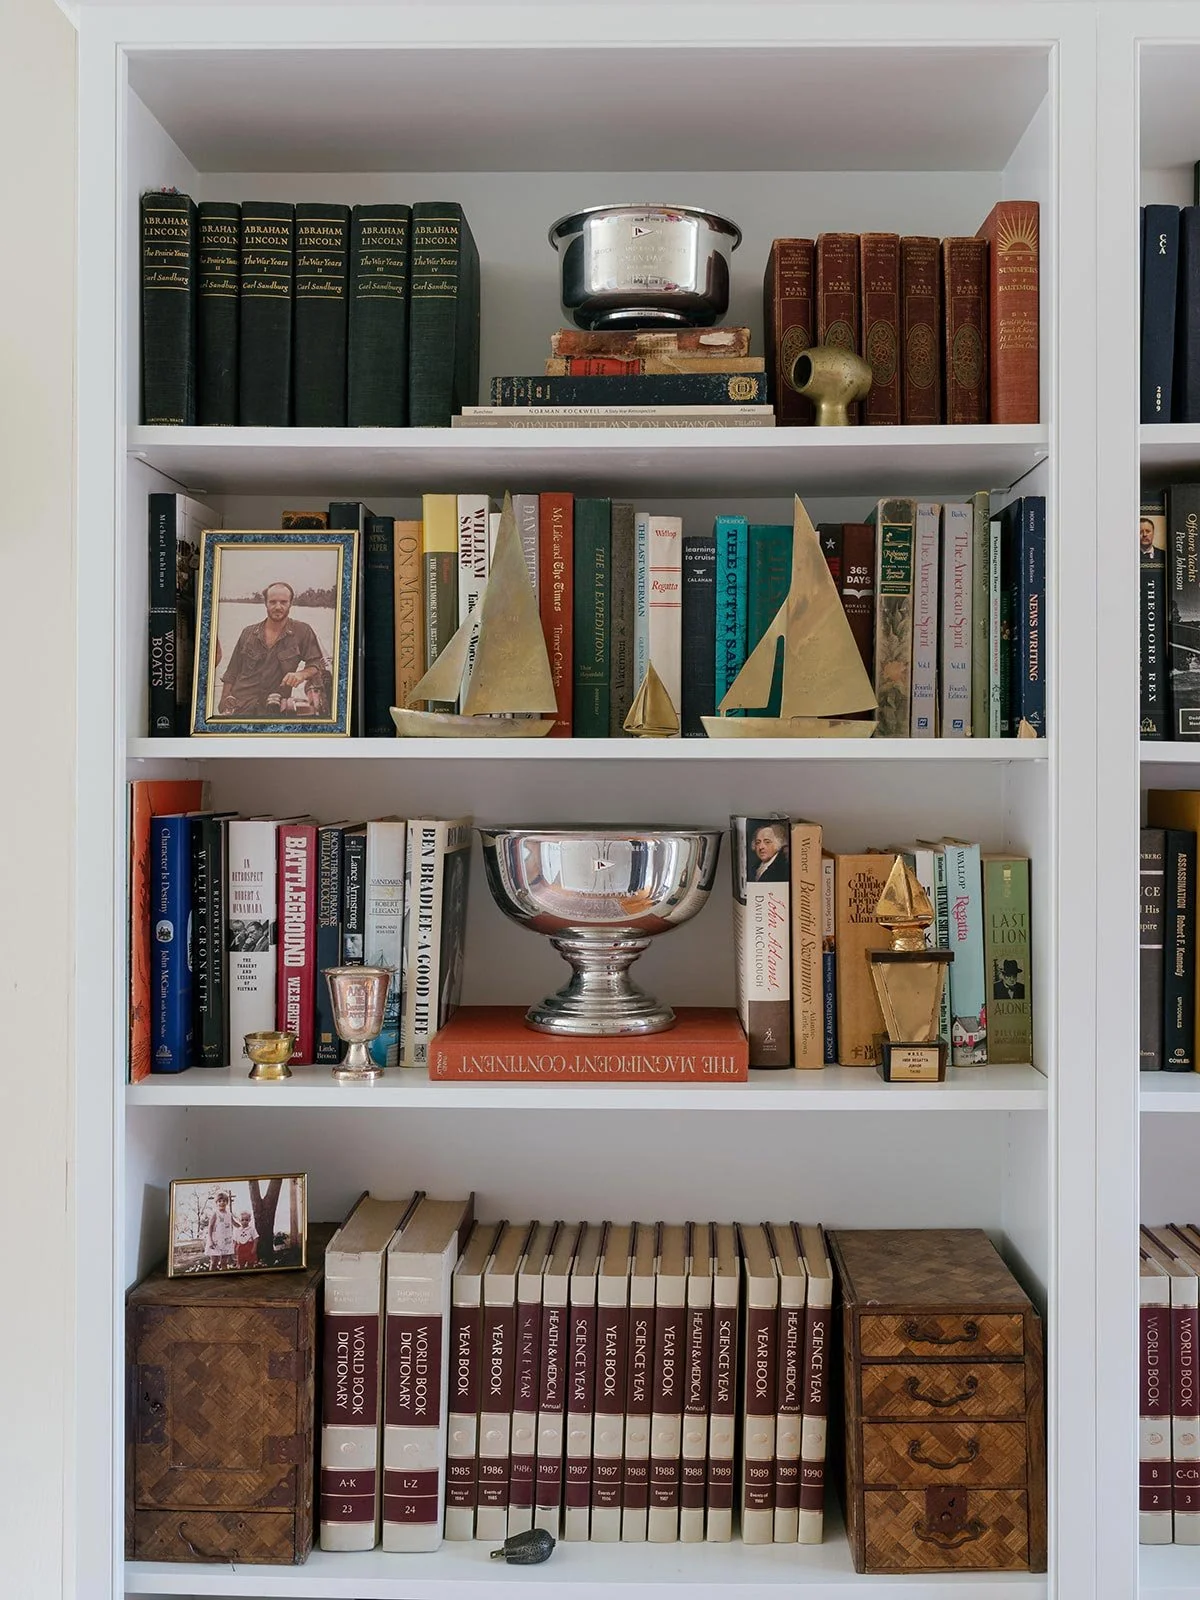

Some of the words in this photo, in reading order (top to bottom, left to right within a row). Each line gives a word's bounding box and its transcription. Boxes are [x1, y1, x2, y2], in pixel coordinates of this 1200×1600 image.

[244, 226, 289, 234] ABRAHAM
[245, 236, 288, 245] LINCOLN
[298, 227, 343, 236] ABRAHAM
[299, 238, 342, 246] LINCOLN
[414, 226, 459, 234] ABRAHAM
[415, 237, 457, 245] LINCOLN
[244, 255, 256, 265] The
[242, 281, 256, 289] Carl
[257, 282, 288, 292] Sandburg
[523, 505, 536, 534] DAN
[551, 507, 562, 523] My
[159, 514, 167, 547] Michael
[460, 516, 472, 570] SAFIRE
[474, 508, 486, 579] WILLIAM
[552, 524, 563, 542] Life
[954, 532, 968, 558] The
[1176, 531, 1186, 554] Peter
[1186, 513, 1198, 551] Offshore
[397, 536, 418, 567] ON
[553, 544, 563, 560] and
[595, 546, 604, 568] THE
[685, 546, 716, 554] learning
[727, 529, 738, 569] THE
[159, 551, 167, 588] Ruhlman
[554, 561, 565, 580] The
[595, 573, 604, 587] RA
[846, 576, 872, 584] DAYS
[850, 566, 868, 574] 365
[1176, 556, 1187, 591] Johnson
[1188, 553, 1198, 583] Yachts
[554, 582, 565, 612] Times
[652, 580, 679, 593] Regatta
[954, 560, 968, 615] American
[429, 612, 437, 627] SUN,
[726, 573, 738, 636] CUTTY
[1029, 594, 1038, 627] NEWS
[399, 574, 418, 670] MENCKEN
[594, 591, 604, 663] EXPEDITIONS
[949, 617, 968, 649] Spirit
[1147, 580, 1156, 664] THEODORE
[553, 624, 564, 651] Turner
[152, 636, 163, 687] BOATS
[164, 630, 174, 691] WOODEN
[615, 640, 626, 690] Watermen
[1029, 630, 1038, 681] WRITING
[1148, 673, 1156, 702] REX
[161, 828, 171, 870] Character
[321, 831, 330, 869] WILLIAM
[330, 831, 338, 857] RACING
[421, 828, 436, 857] BEN
[800, 837, 811, 873] Warner
[161, 872, 170, 880] Is
[232, 872, 264, 882] RETROSPECT
[244, 858, 250, 869] IN
[330, 858, 338, 893] THROUGH
[350, 855, 361, 882] Lance
[957, 851, 966, 889] WALLOP
[198, 849, 207, 915] WALTER
[234, 891, 254, 900] ROBERT
[1177, 852, 1187, 909] ASSASSINATION
[158, 882, 170, 914] Destiny
[283, 836, 307, 968] BATTLEGROUND
[320, 878, 330, 917] BUCKLEY,
[330, 894, 338, 927] PARADISE
[348, 883, 361, 929] Armstrong
[418, 863, 433, 932] BRADLEE
[754, 895, 764, 922] DAVID
[767, 892, 786, 930] John
[799, 880, 816, 936] Beautiful
[937, 885, 948, 917] VIETNAM
[1145, 905, 1160, 914] His
[848, 914, 872, 923] Allan
[951, 895, 970, 942] Regatta
[992, 914, 1025, 928] LAST
[1176, 915, 1186, 938] Robert
[418, 941, 430, 950] A
[992, 929, 1027, 944] LION
[160, 949, 170, 968] John
[198, 925, 208, 1013] CRONKITE
[754, 926, 765, 987] McCULLOUGH
[801, 938, 815, 1005] Swimmers
[1175, 947, 1185, 977] Kennedy
[161, 969, 170, 998] McCain
[416, 954, 430, 997] GOOD
[414, 1003, 429, 1035] LIFE
[994, 1003, 1028, 1015] ALONE
[457, 1054, 566, 1074] CONTINENT
[568, 1055, 696, 1074] MAGNIFICENT
[702, 1056, 739, 1073] THE
[458, 1325, 471, 1356] YEAR
[548, 1310, 559, 1347] HEALTH
[575, 1319, 588, 1367] SCIENCE
[1146, 1316, 1159, 1366] WORLD
[352, 1326, 365, 1374] WORLD
[812, 1321, 824, 1370] SCIENCE
[336, 1331, 349, 1409] DICTIONARY
[457, 1358, 470, 1396] BOOK
[546, 1356, 558, 1400] MEDICAL
[574, 1370, 586, 1400] YEAR
[352, 1377, 364, 1415] BOOK
[810, 1373, 822, 1403] YEAR
[1148, 1369, 1160, 1407] BOOK
[339, 1479, 357, 1487] A-K
[403, 1480, 418, 1489] L-Z
[451, 1467, 471, 1476] 1985
[483, 1466, 503, 1475] 1986
[803, 1469, 823, 1478] 1990
[1176, 1470, 1199, 1478] C-Ch
[342, 1504, 353, 1513] 23
[405, 1505, 416, 1514] 24
